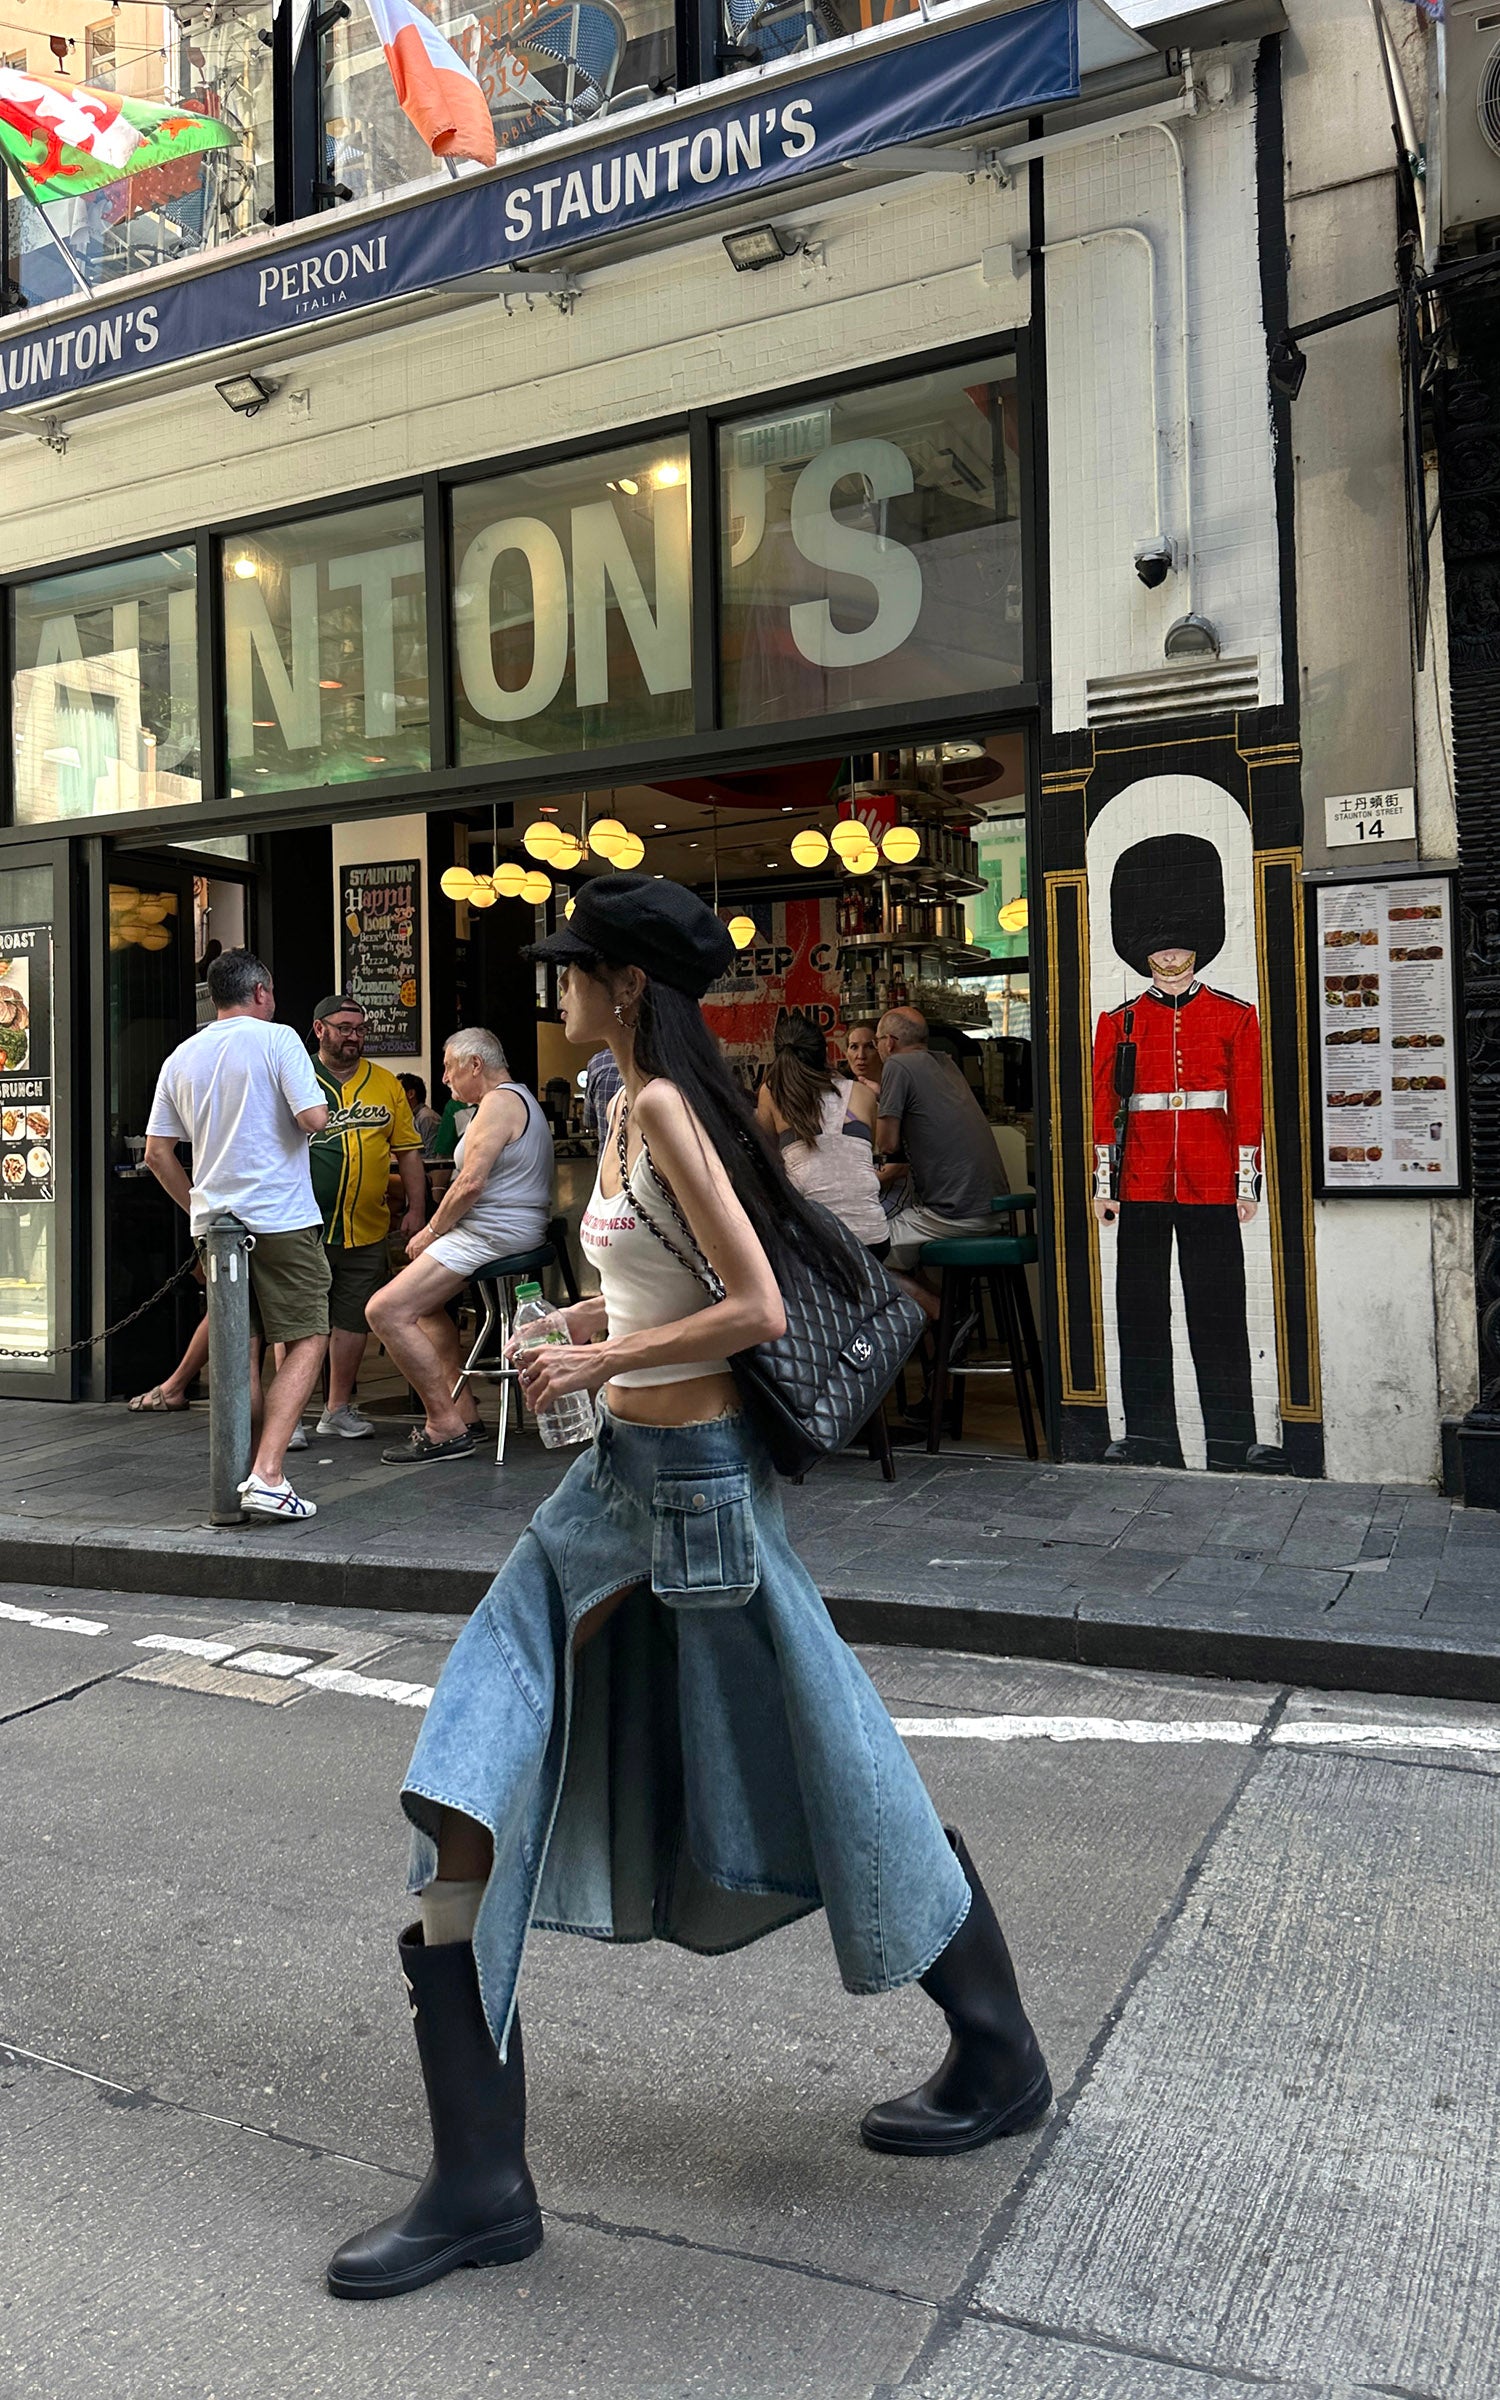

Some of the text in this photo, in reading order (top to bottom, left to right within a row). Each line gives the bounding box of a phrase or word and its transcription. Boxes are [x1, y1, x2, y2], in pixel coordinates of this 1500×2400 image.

[504, 98, 816, 242] STAUNTON'S
[258, 235, 388, 307] PERONI
[295, 290, 347, 315] ITALIA
[1334, 806, 1404, 822] STAUNTON STREET
[1355, 819, 1385, 840] 14
[726, 946, 796, 979] EEP
[0, 1081, 43, 1098] RUNCH
[328, 1101, 389, 1125] ackers
